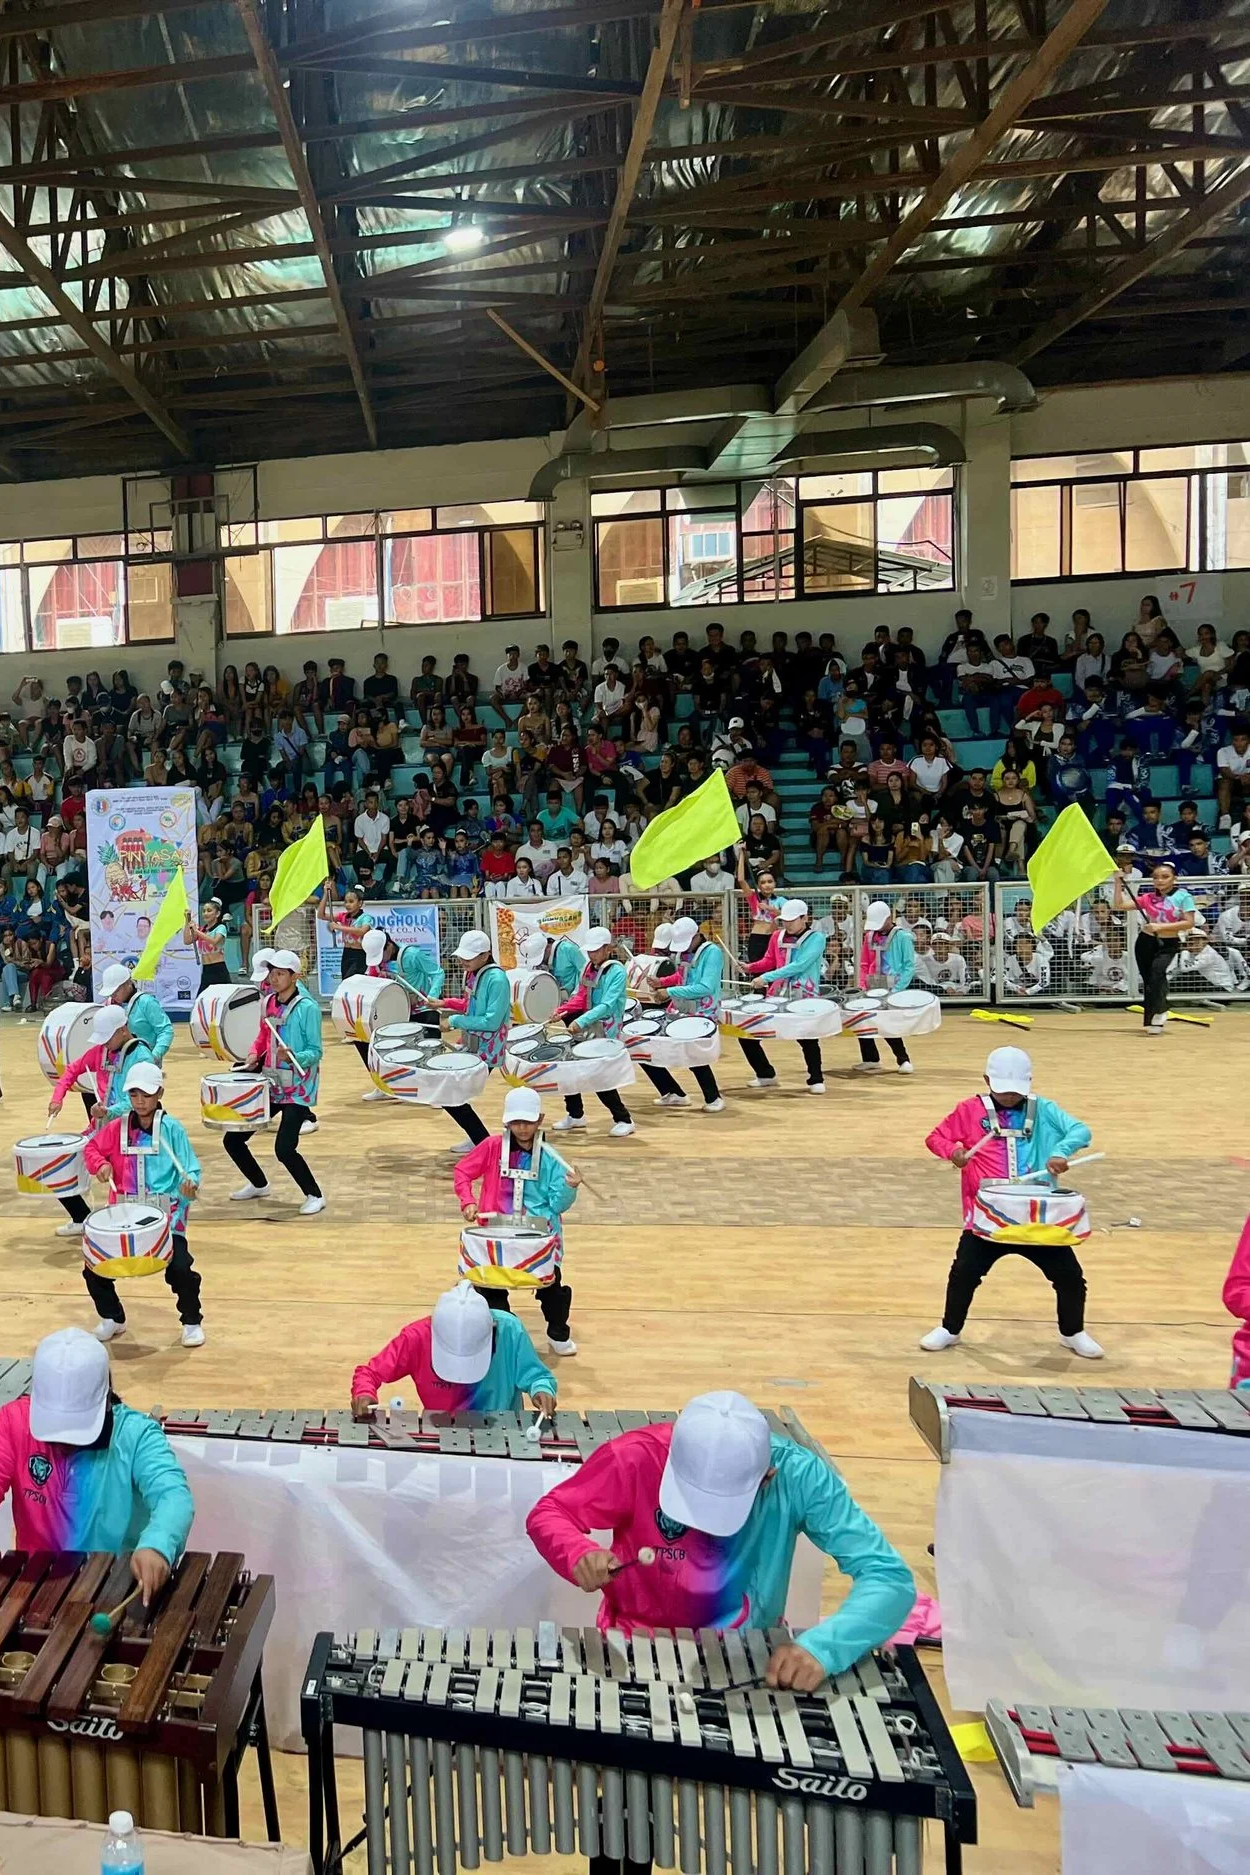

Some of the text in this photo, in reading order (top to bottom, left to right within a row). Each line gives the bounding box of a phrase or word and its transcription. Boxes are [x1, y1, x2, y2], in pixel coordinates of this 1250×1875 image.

[119, 848, 190, 863] PINYASAN
[370, 913, 428, 928] ONGHOLD
[771, 1767, 871, 1801] Saito
